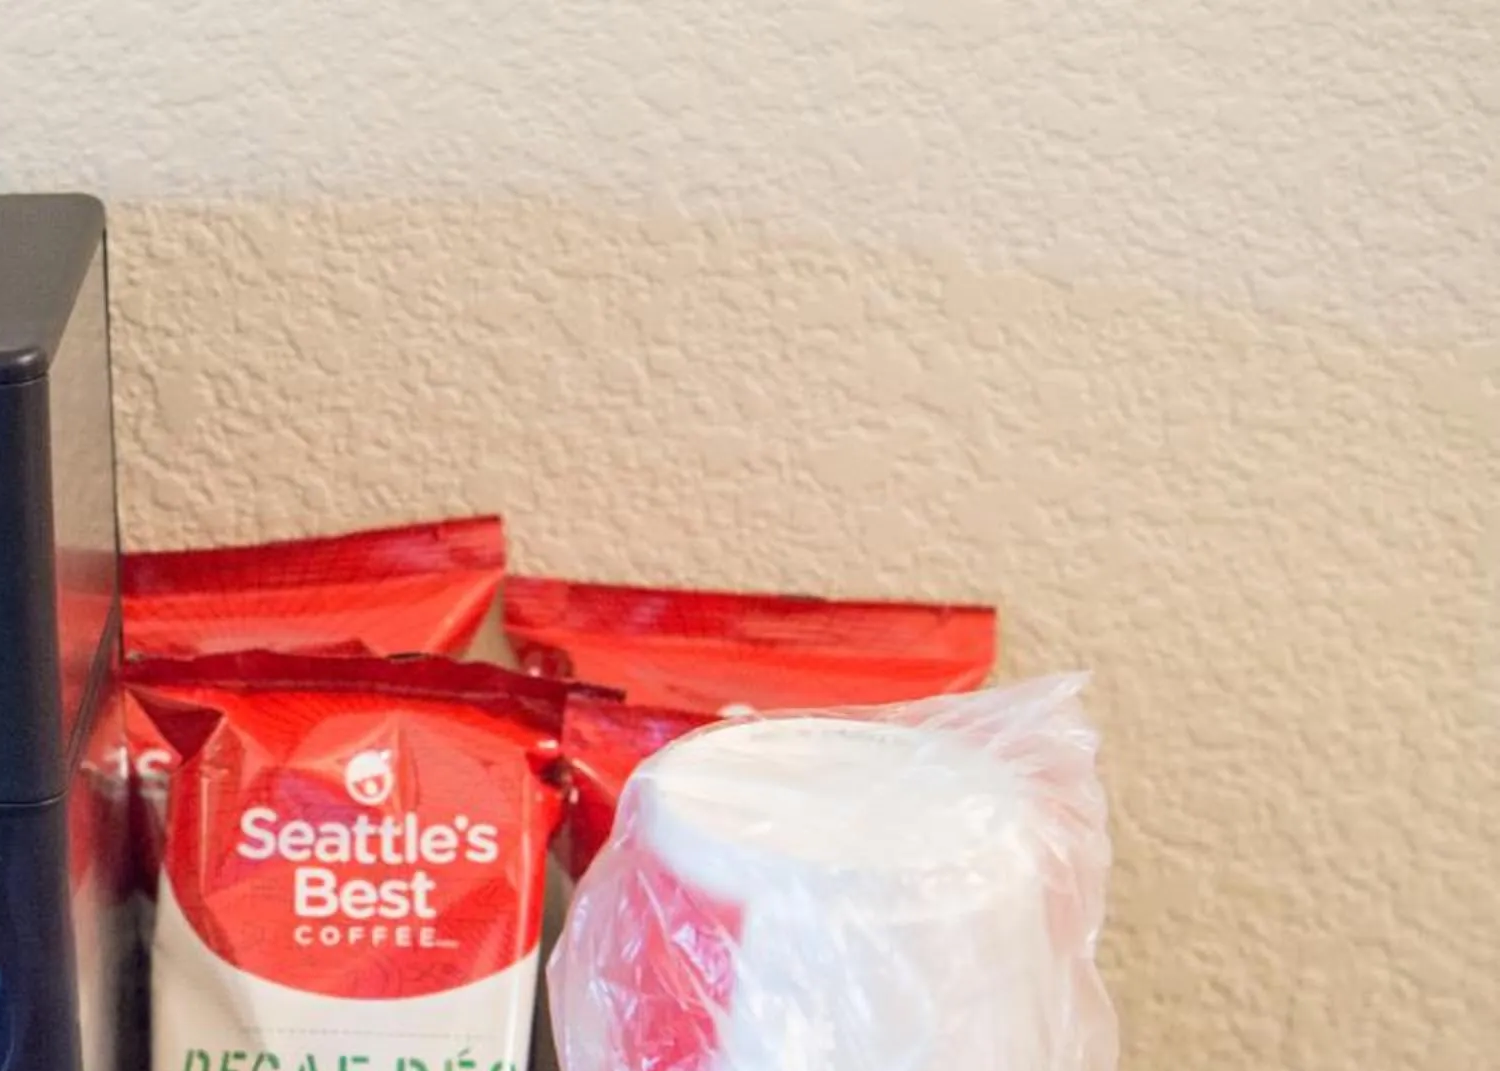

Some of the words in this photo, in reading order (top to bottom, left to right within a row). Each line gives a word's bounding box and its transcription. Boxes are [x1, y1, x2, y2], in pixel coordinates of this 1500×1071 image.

[236, 807, 499, 865] Seattle's
[293, 867, 437, 918] Best
[294, 925, 437, 948] COFFEE
